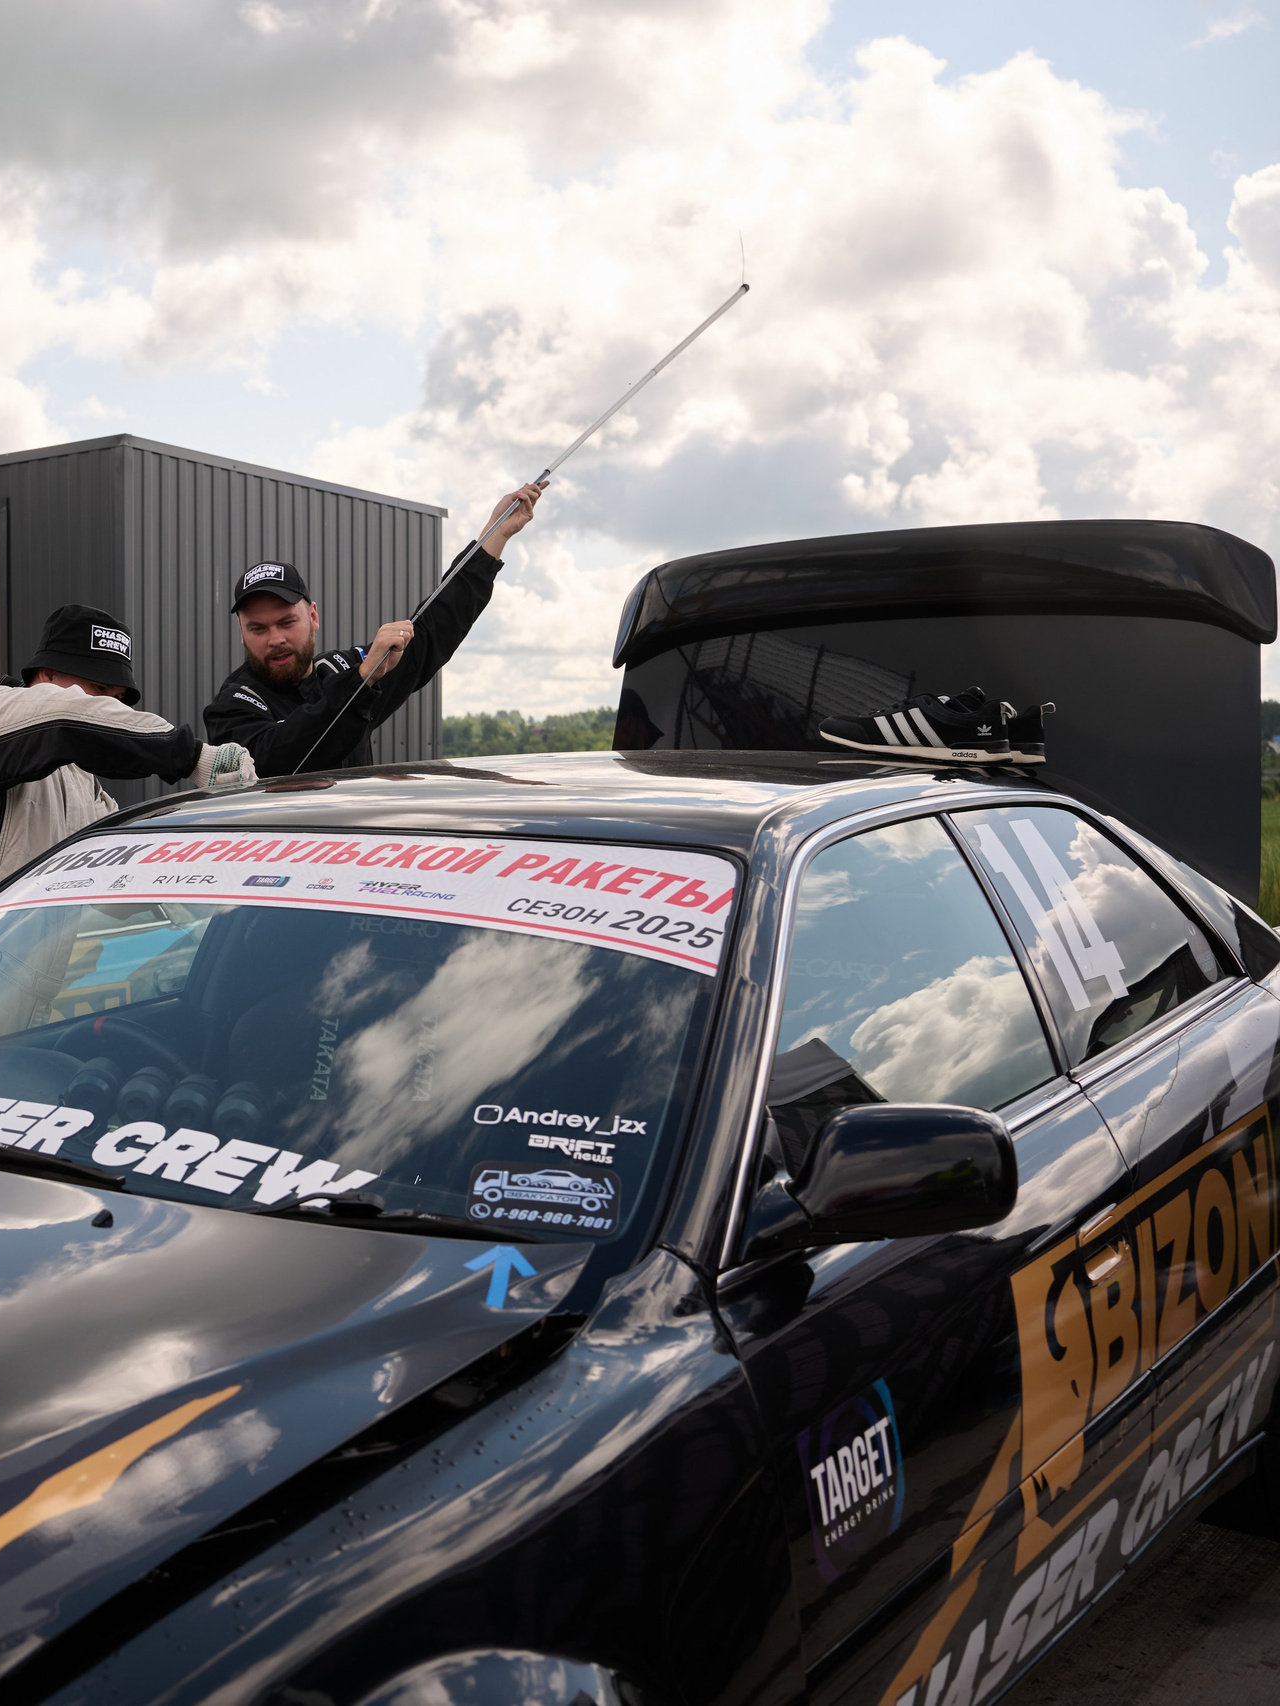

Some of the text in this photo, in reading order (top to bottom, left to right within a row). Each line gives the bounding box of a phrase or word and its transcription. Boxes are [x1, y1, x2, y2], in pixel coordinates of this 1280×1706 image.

[246, 565, 282, 580] CHASER
[248, 571, 277, 584] CREW
[94, 629, 130, 647] CHASER
[98, 639, 127, 653] CREW
[951, 751, 978, 759] adidas
[24, 839, 735, 915] КУБОК БАРНАУЛЬСКОЙ РАКЕТЫ
[152, 875, 218, 884] RIVER
[360, 880, 422, 891] HYPER
[349, 915, 442, 939] RECARO
[507, 898, 724, 949] СЕЗОН 2025
[973, 818, 1129, 1012] 14
[789, 958, 891, 983] ECARO
[310, 1018, 339, 1101] TAKATA
[412, 1015, 438, 1102] TAKATA
[503, 1107, 648, 1136] Andrey_jzx
[91, 1121, 380, 1208] CREW
[573, 1151, 614, 1164] news
[505, 1190, 581, 1205] ЭВАКУАТОР
[493, 1207, 613, 1230] 8-960-960-7001
[1089, 1132, 1273, 1418] BIZON
[1120, 1340, 1275, 1557] CREW
[810, 1415, 893, 1527] TARGET
[824, 1485, 895, 1548] ENERGY DRINK
